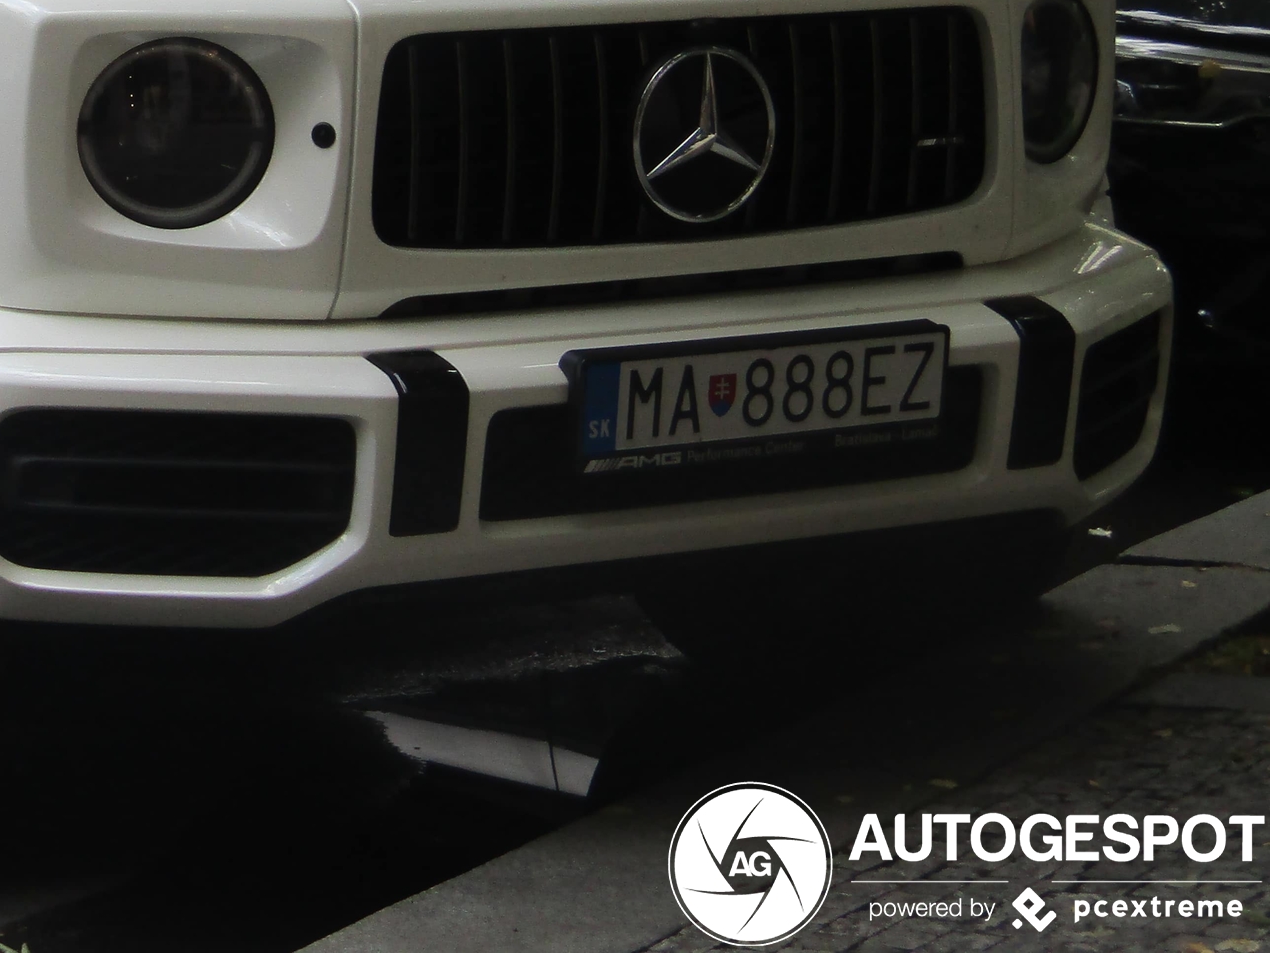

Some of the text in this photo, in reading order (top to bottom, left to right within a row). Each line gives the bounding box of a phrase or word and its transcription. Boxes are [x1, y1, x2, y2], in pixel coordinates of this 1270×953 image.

[626, 341, 935, 440] MA 888EZ
[588, 418, 611, 439] SK
[616, 450, 682, 469] AMG
[687, 446, 761, 463] Performance
